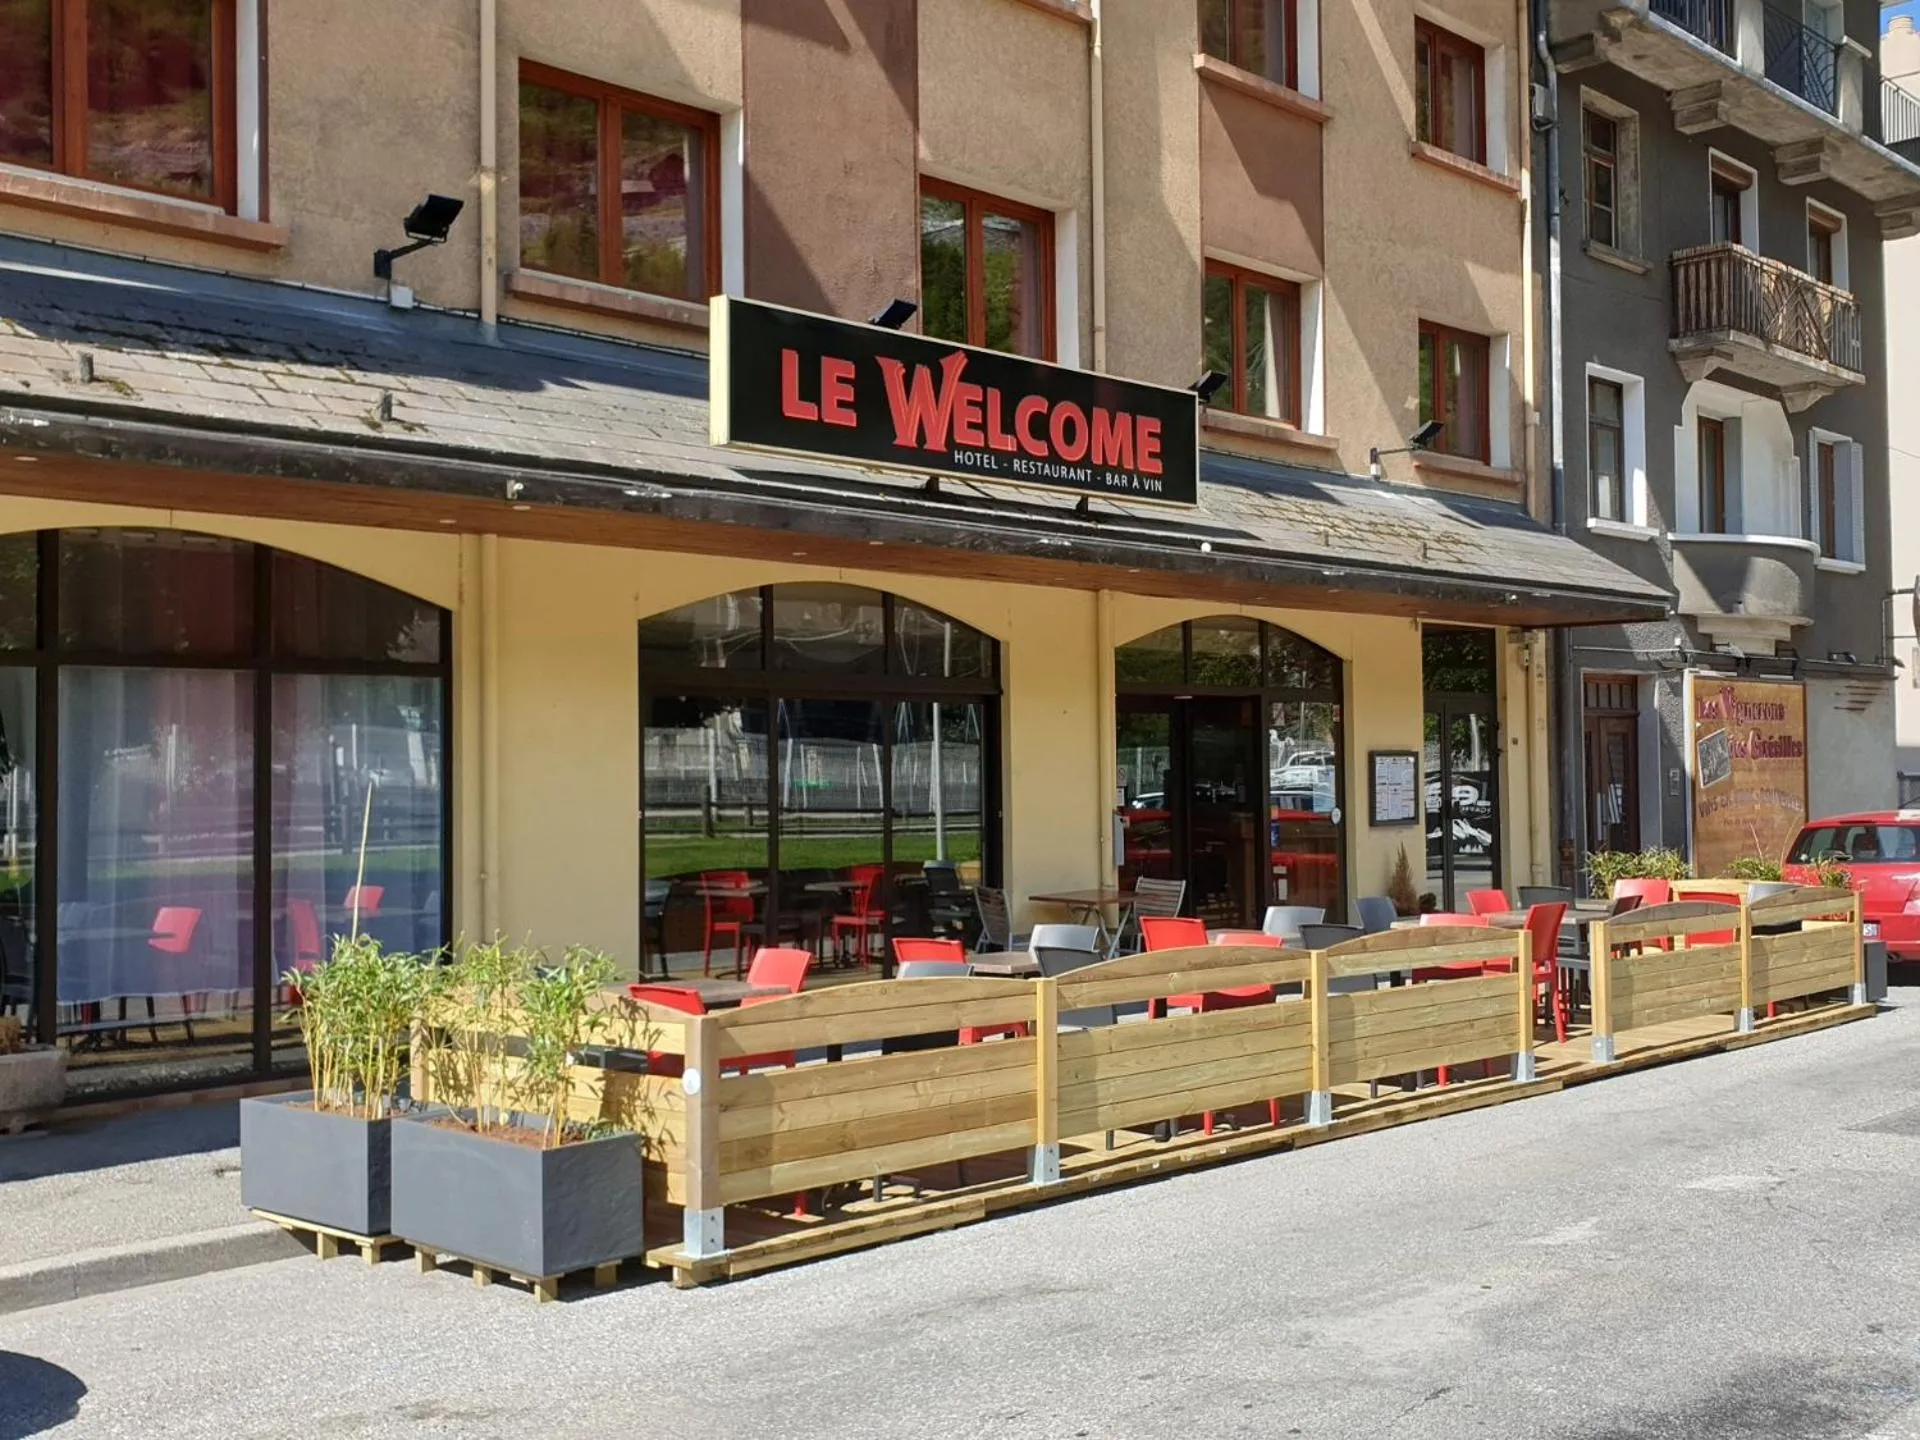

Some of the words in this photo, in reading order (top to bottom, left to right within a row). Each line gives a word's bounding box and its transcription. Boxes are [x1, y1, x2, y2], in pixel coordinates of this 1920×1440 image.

[782, 348, 857, 427] LE
[875, 350, 1163, 474] WELCOME
[954, 449, 999, 470] HOTEL
[1013, 458, 1092, 482] RESTAURANT
[1105, 472, 1128, 488] BAR
[1132, 474, 1140, 490] À
[1143, 478, 1163, 493] VIN
